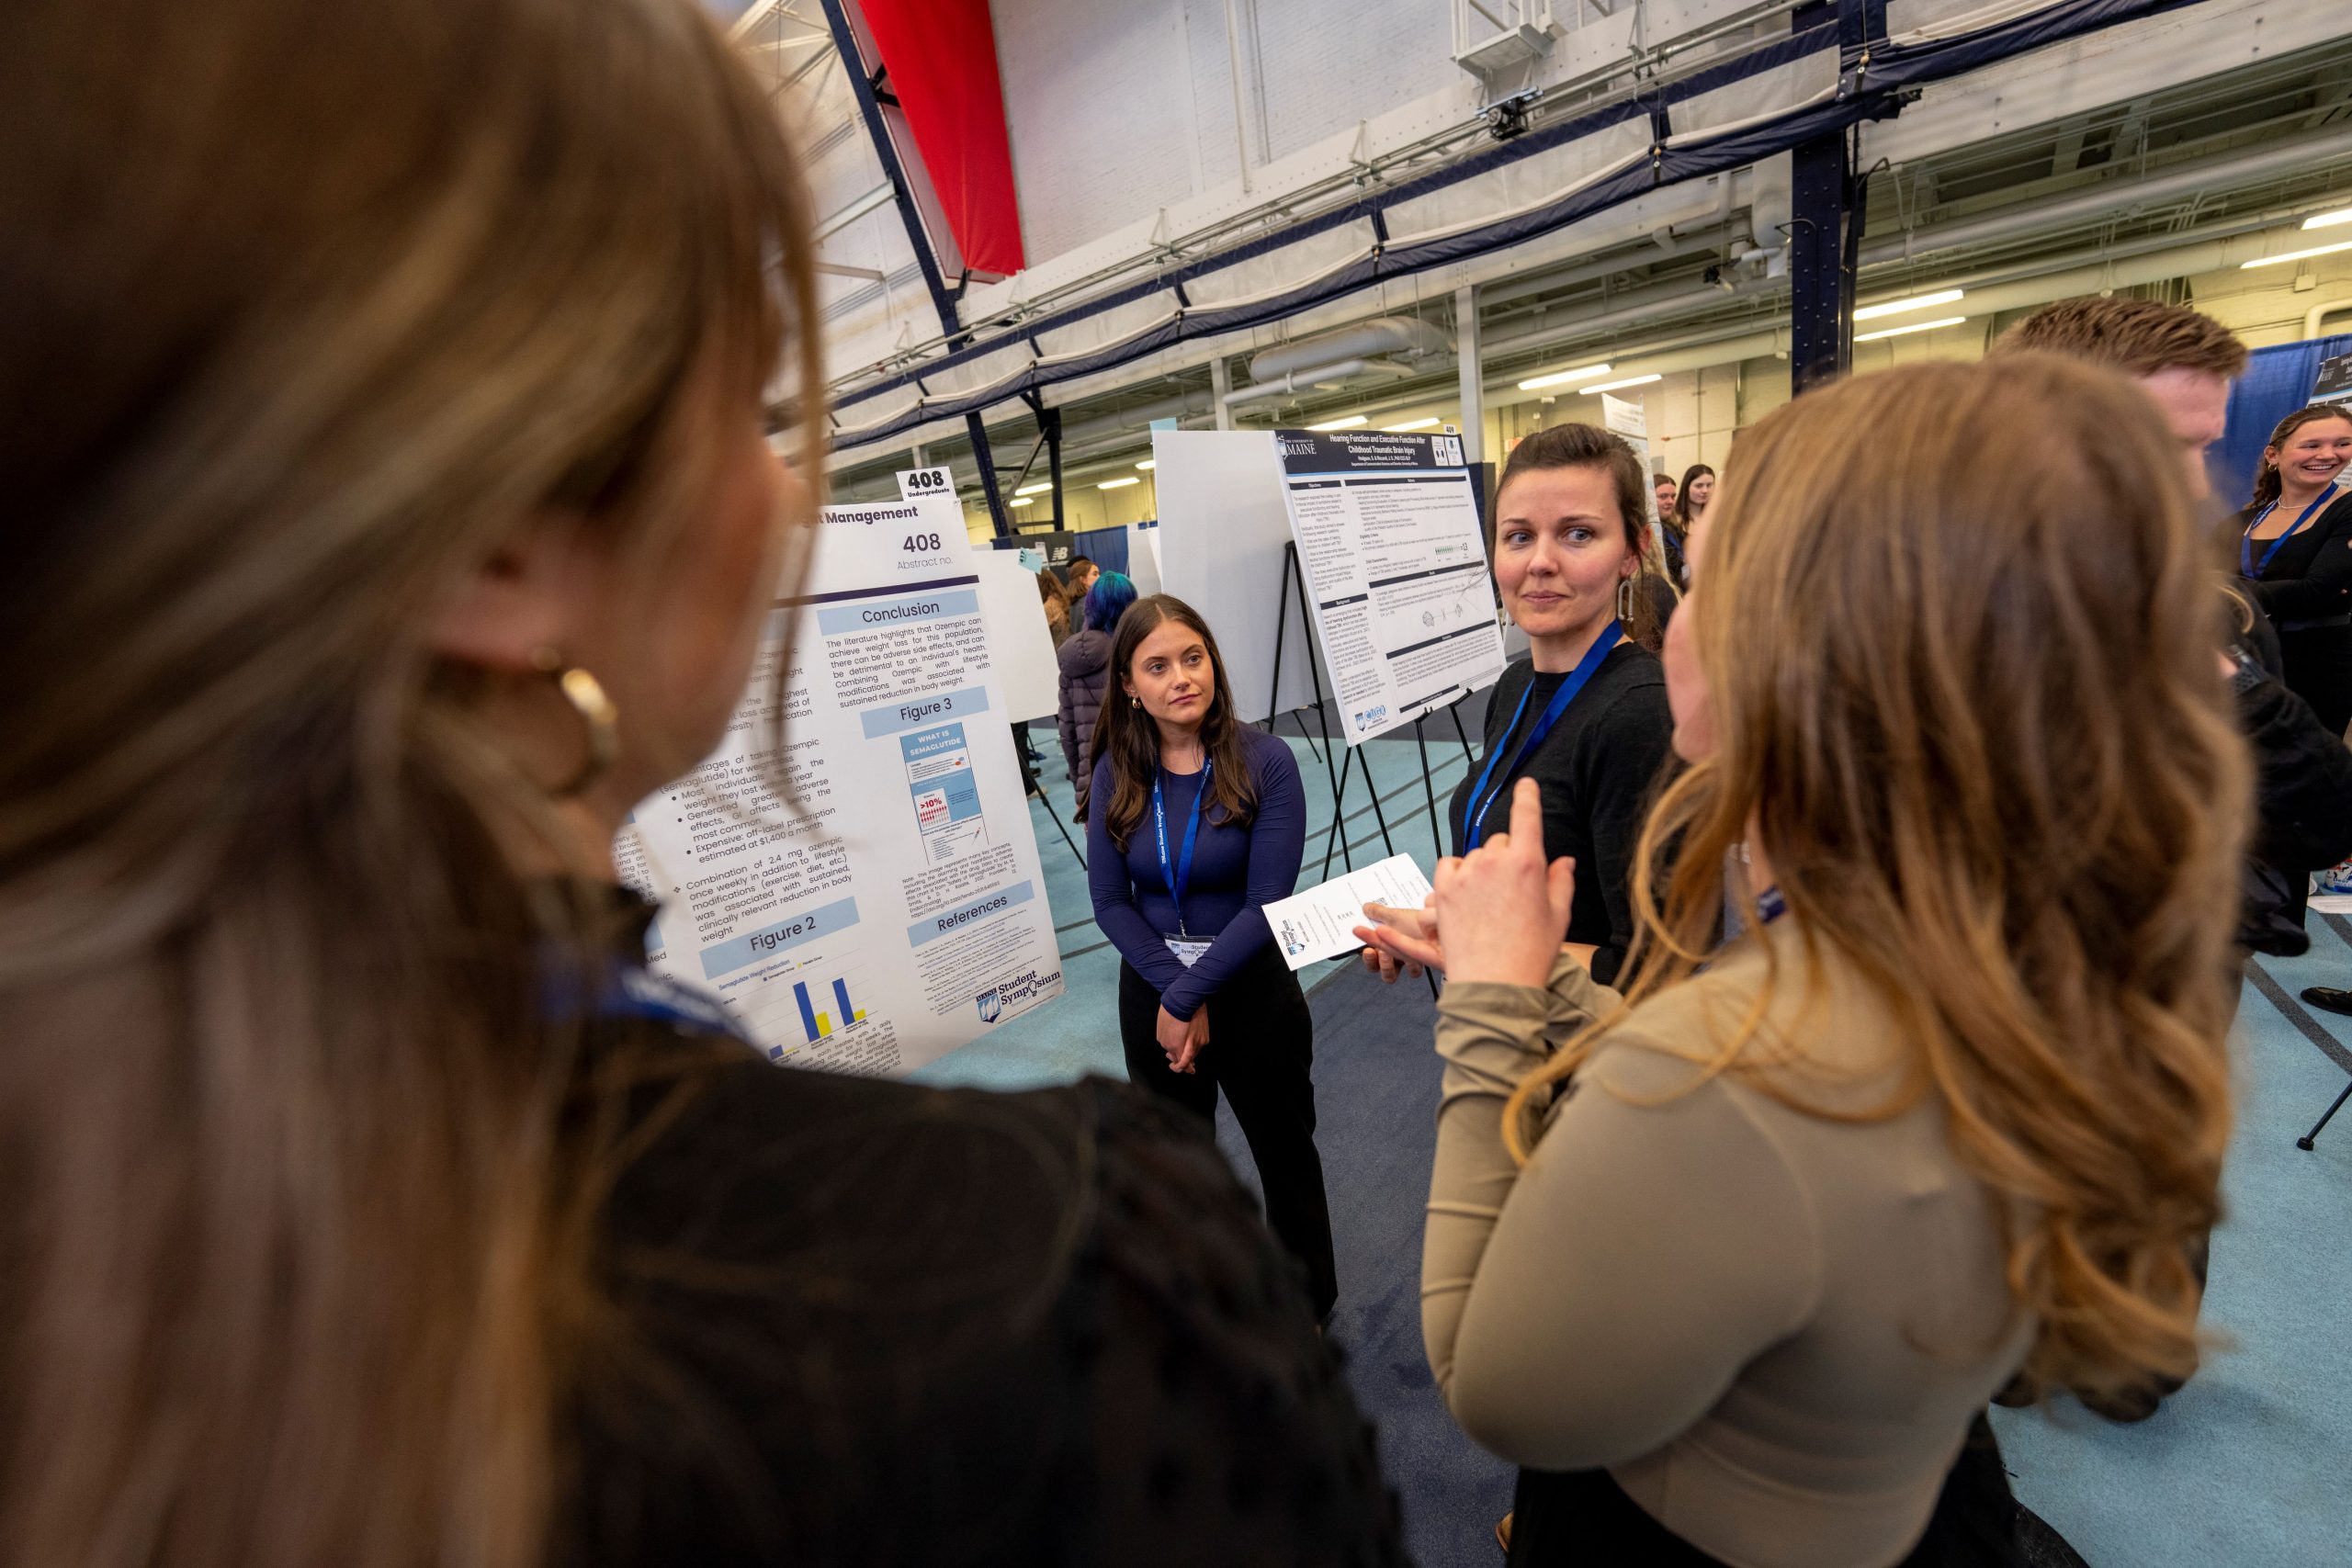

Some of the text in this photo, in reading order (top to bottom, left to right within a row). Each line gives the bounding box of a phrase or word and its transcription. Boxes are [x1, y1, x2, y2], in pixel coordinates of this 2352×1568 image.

[1286, 444, 1317, 455] MAINE
[1329, 434, 1349, 444] Hearing
[1350, 435, 1369, 443] Function
[1404, 447, 1415, 455] Injury
[907, 487, 950, 497] Undergraduate
[908, 470, 944, 489] 408
[824, 506, 919, 525] Management
[903, 533, 941, 553] 408
[897, 557, 953, 570] Abstract no.
[862, 602, 940, 623] Conclusion
[829, 647, 860, 658] achieve
[865, 642, 890, 653] weight
[894, 639, 908, 648] loss
[927, 633, 940, 642] this
[945, 627, 983, 639] population,
[844, 634, 878, 645] literature
[881, 627, 914, 641] highlights
[917, 625, 932, 633] that
[935, 619, 966, 631] Ozempic
[831, 658, 852, 668] there
[854, 656, 870, 664] can
[883, 648, 911, 659] adverse
[913, 645, 927, 653] side
[929, 641, 954, 651] effects,
[956, 637, 969, 646] and
[833, 670, 844, 679] be
[849, 662, 892, 676] detrimental
[922, 650, 959, 662] individual's
[963, 645, 986, 654] health.
[835, 653, 988, 688] Combining Ozempic with lifestyle
[838, 662, 990, 699] modifications was associated with
[802, 698, 810, 706] of
[840, 695, 878, 708] sustained
[879, 686, 914, 700] reduction
[922, 680, 938, 692] body
[940, 676, 965, 688] weight.
[900, 697, 952, 722] Figure 3
[736, 737, 820, 764] of taking Ozempic
[910, 737, 961, 756] SEMAGLUTIDE
[918, 732, 940, 743] WHAT
[660, 768, 729, 795] (semaglutide)
[731, 768, 744, 776] for
[681, 787, 705, 800] Most
[716, 772, 765, 791] individuals
[810, 758, 824, 767] the
[684, 772, 814, 810] weight they lost year
[687, 778, 829, 821] Generated adverse
[690, 818, 725, 832] effects,
[732, 808, 742, 819] GI
[749, 802, 780, 816] affects
[817, 788, 831, 797] the
[920, 798, 942, 809] >10%
[693, 818, 761, 842] most common
[696, 807, 836, 853] Expensive: off-label prescription
[699, 842, 746, 863] estimated
[748, 840, 758, 848] at
[759, 831, 786, 846] $1,400
[796, 821, 823, 835] month
[686, 836, 843, 890] Combination of 2.4 mg ozempic
[690, 888, 714, 900] once
[716, 877, 748, 892] weekly
[751, 873, 759, 881] in
[762, 861, 798, 877] addition
[815, 846, 845, 860] lifestyle
[693, 854, 847, 911] modifications (exercise, diet, etc.)
[695, 865, 850, 922] was associated with sustained,
[699, 873, 852, 933] clinically relevant reduction in body
[938, 896, 1007, 932] References
[701, 926, 734, 943] weight
[750, 916, 816, 951] Figure 2
[718, 959, 790, 991] Semaglutide Weight Reduction
[998, 969, 1037, 995] Student
[1001, 970, 1061, 1005] Symposium
[976, 987, 998, 1002] MAINE
[835, 1037, 854, 1051] treated
[880, 1020, 892, 1029] daily
